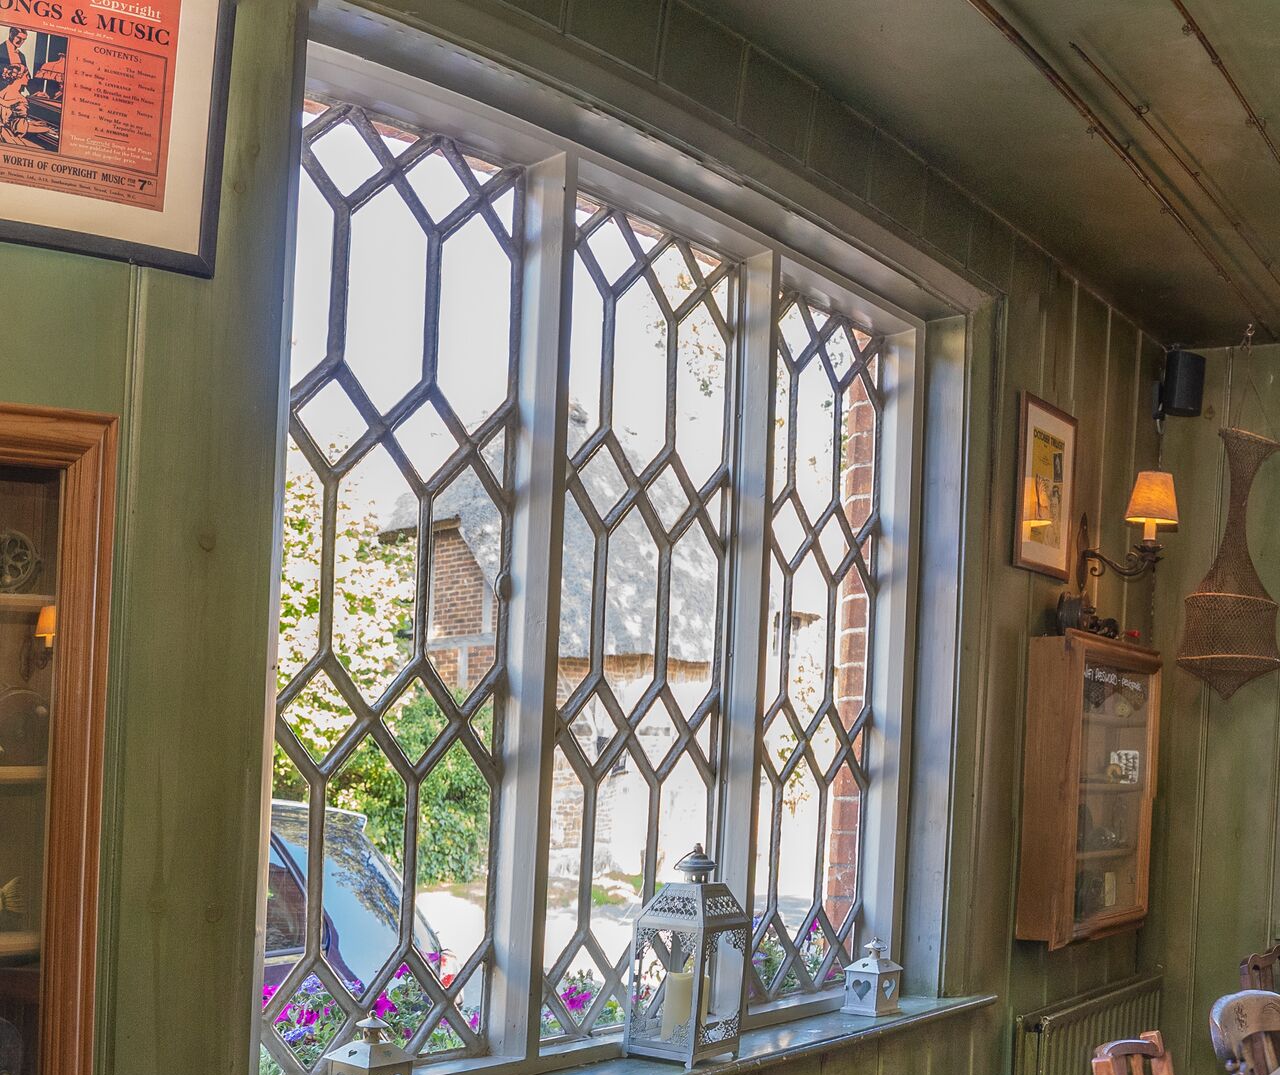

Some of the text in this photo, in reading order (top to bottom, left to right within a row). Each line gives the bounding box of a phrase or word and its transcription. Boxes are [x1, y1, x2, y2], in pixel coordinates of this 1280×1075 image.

[71, 9, 87, 27] &
[97, 14, 170, 46] MUSIC
[94, 46, 142, 63] CONTENTS:
[3, 154, 34, 168] WORTH
[37, 160, 48, 170] OF
[51, 163, 98, 180] COPYRIGHT
[101, 172, 126, 185] MUSIC
